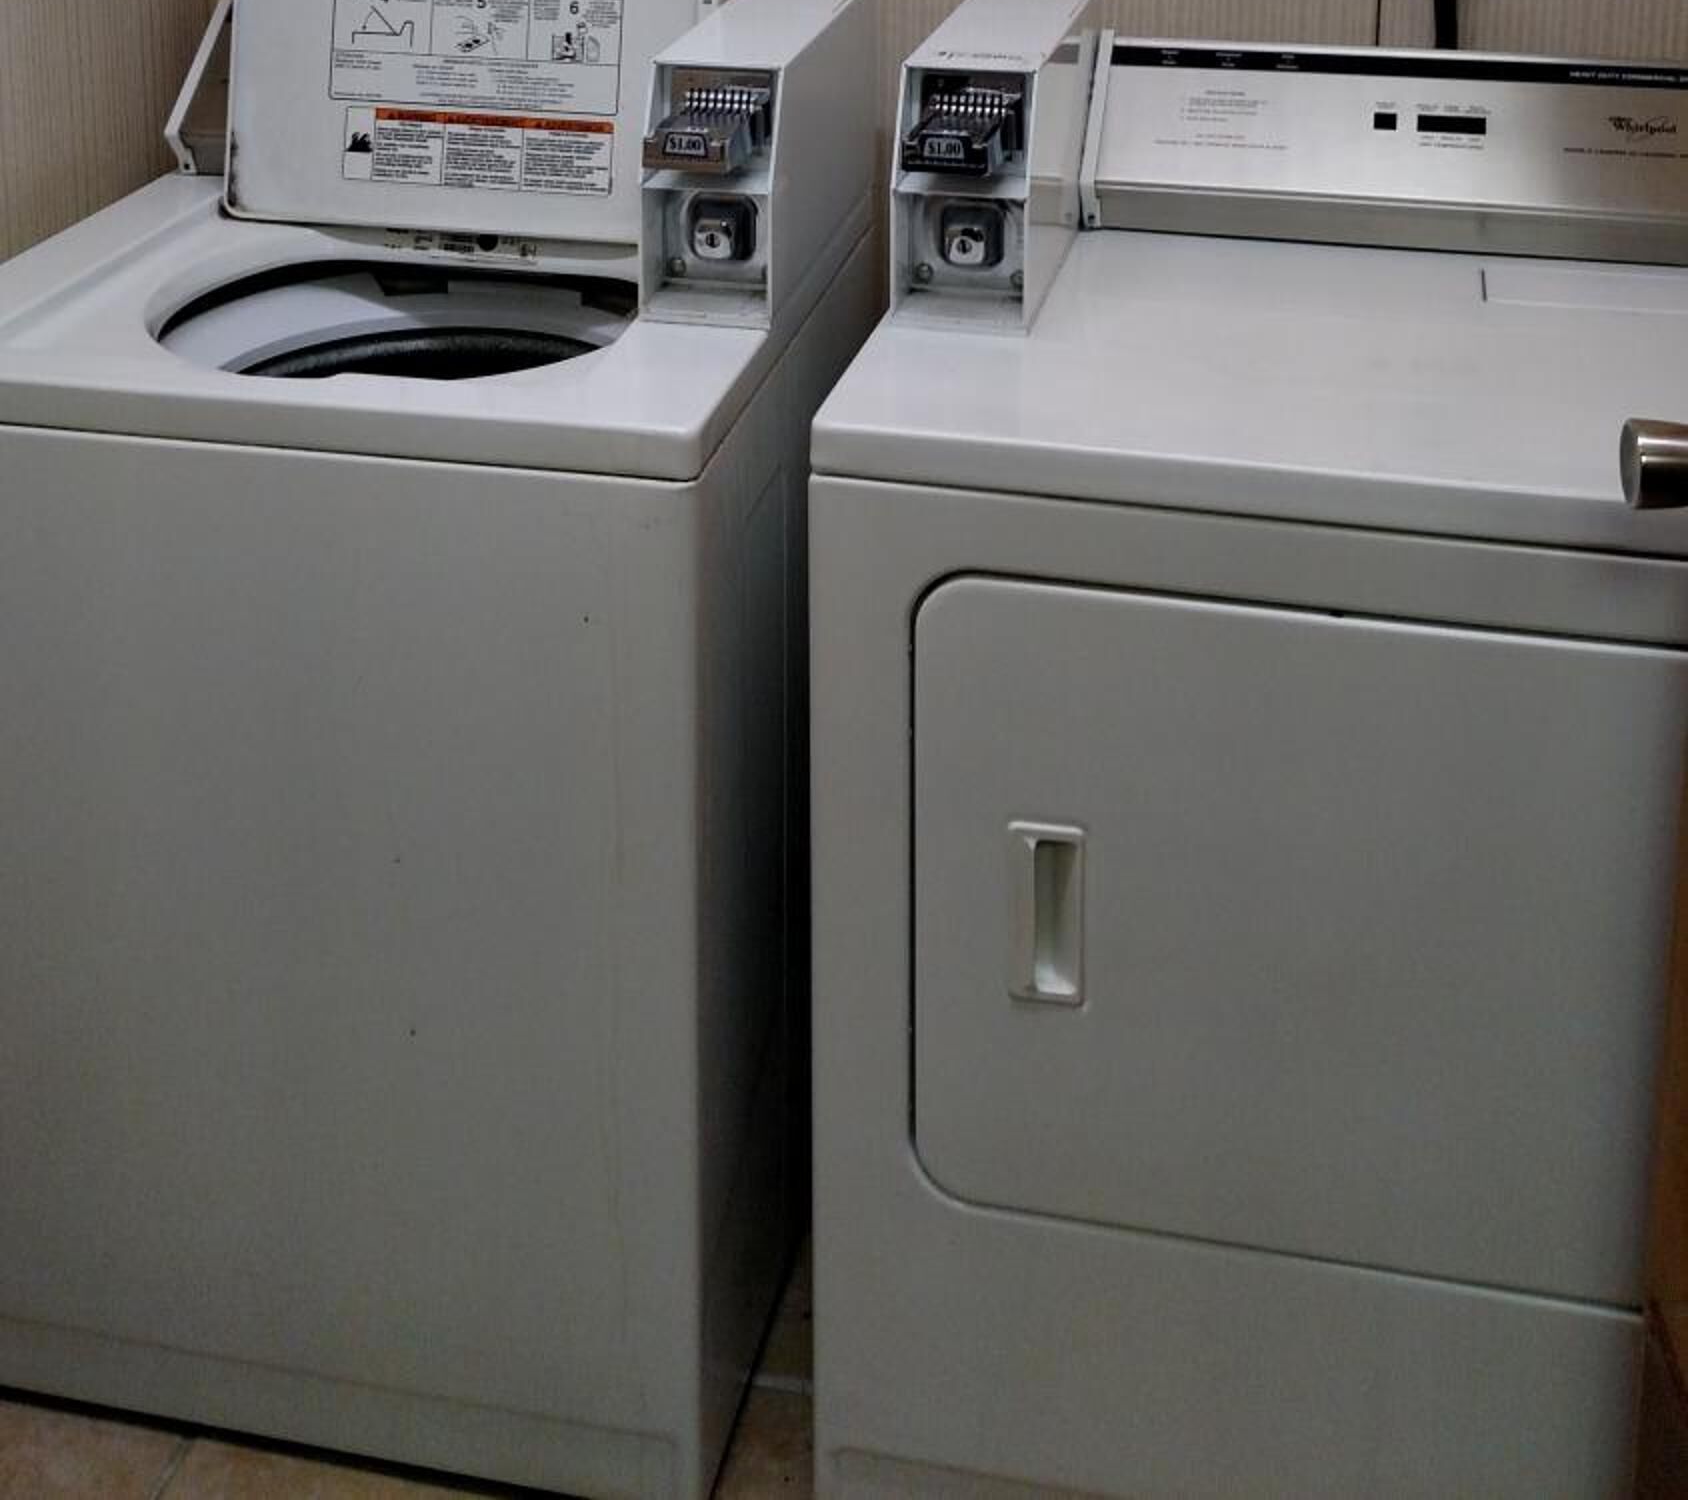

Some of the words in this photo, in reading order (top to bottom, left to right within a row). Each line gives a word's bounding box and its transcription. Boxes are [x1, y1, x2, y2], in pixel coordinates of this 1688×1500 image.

[569, 0, 579, 14] 6
[1608, 116, 1677, 135] Whirlpool
[668, 134, 701, 151] $1.00
